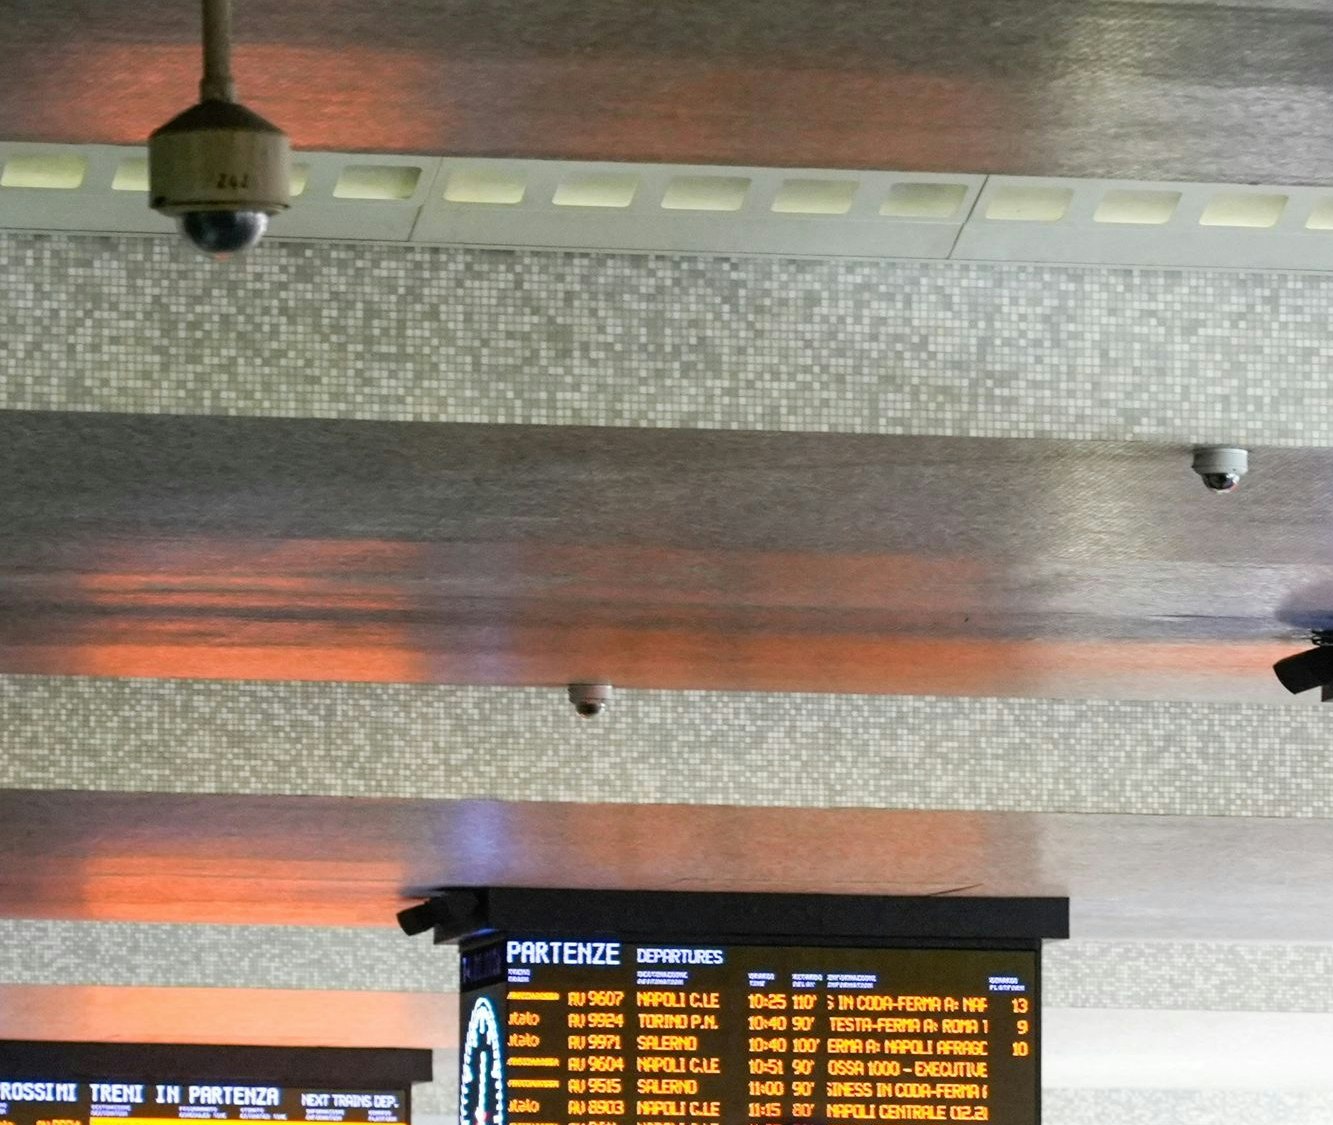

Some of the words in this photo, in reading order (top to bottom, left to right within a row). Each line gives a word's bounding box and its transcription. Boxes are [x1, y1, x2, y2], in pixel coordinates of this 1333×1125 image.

[507, 941, 620, 965] PARTENZE
[637, 948, 723, 964] DEPARTURES
[637, 991, 686, 1007] NAPOLI
[748, 993, 787, 1009] 10:25
[1012, 998, 1029, 1013] 13
[638, 1013, 688, 1028] TORINO
[748, 1015, 787, 1031] 10:40
[1017, 1020, 1029, 1034] 9
[637, 1035, 698, 1051] SALERNO
[749, 1037, 787, 1053] 10:40
[1013, 1041, 1029, 1056] 10
[637, 1056, 686, 1072] NAPOLI
[748, 1059, 785, 1074] 10:51
[89, 1084, 144, 1103] TRENI
[156, 1085, 181, 1103] IN
[189, 1086, 281, 1106] PARTENZA
[301, 1093, 329, 1107] NEXT
[332, 1094, 372, 1108] TRAINS
[373, 1095, 400, 1108] DEP.
[637, 1079, 699, 1094] SALERNO
[748, 1081, 785, 1096] 11:00
